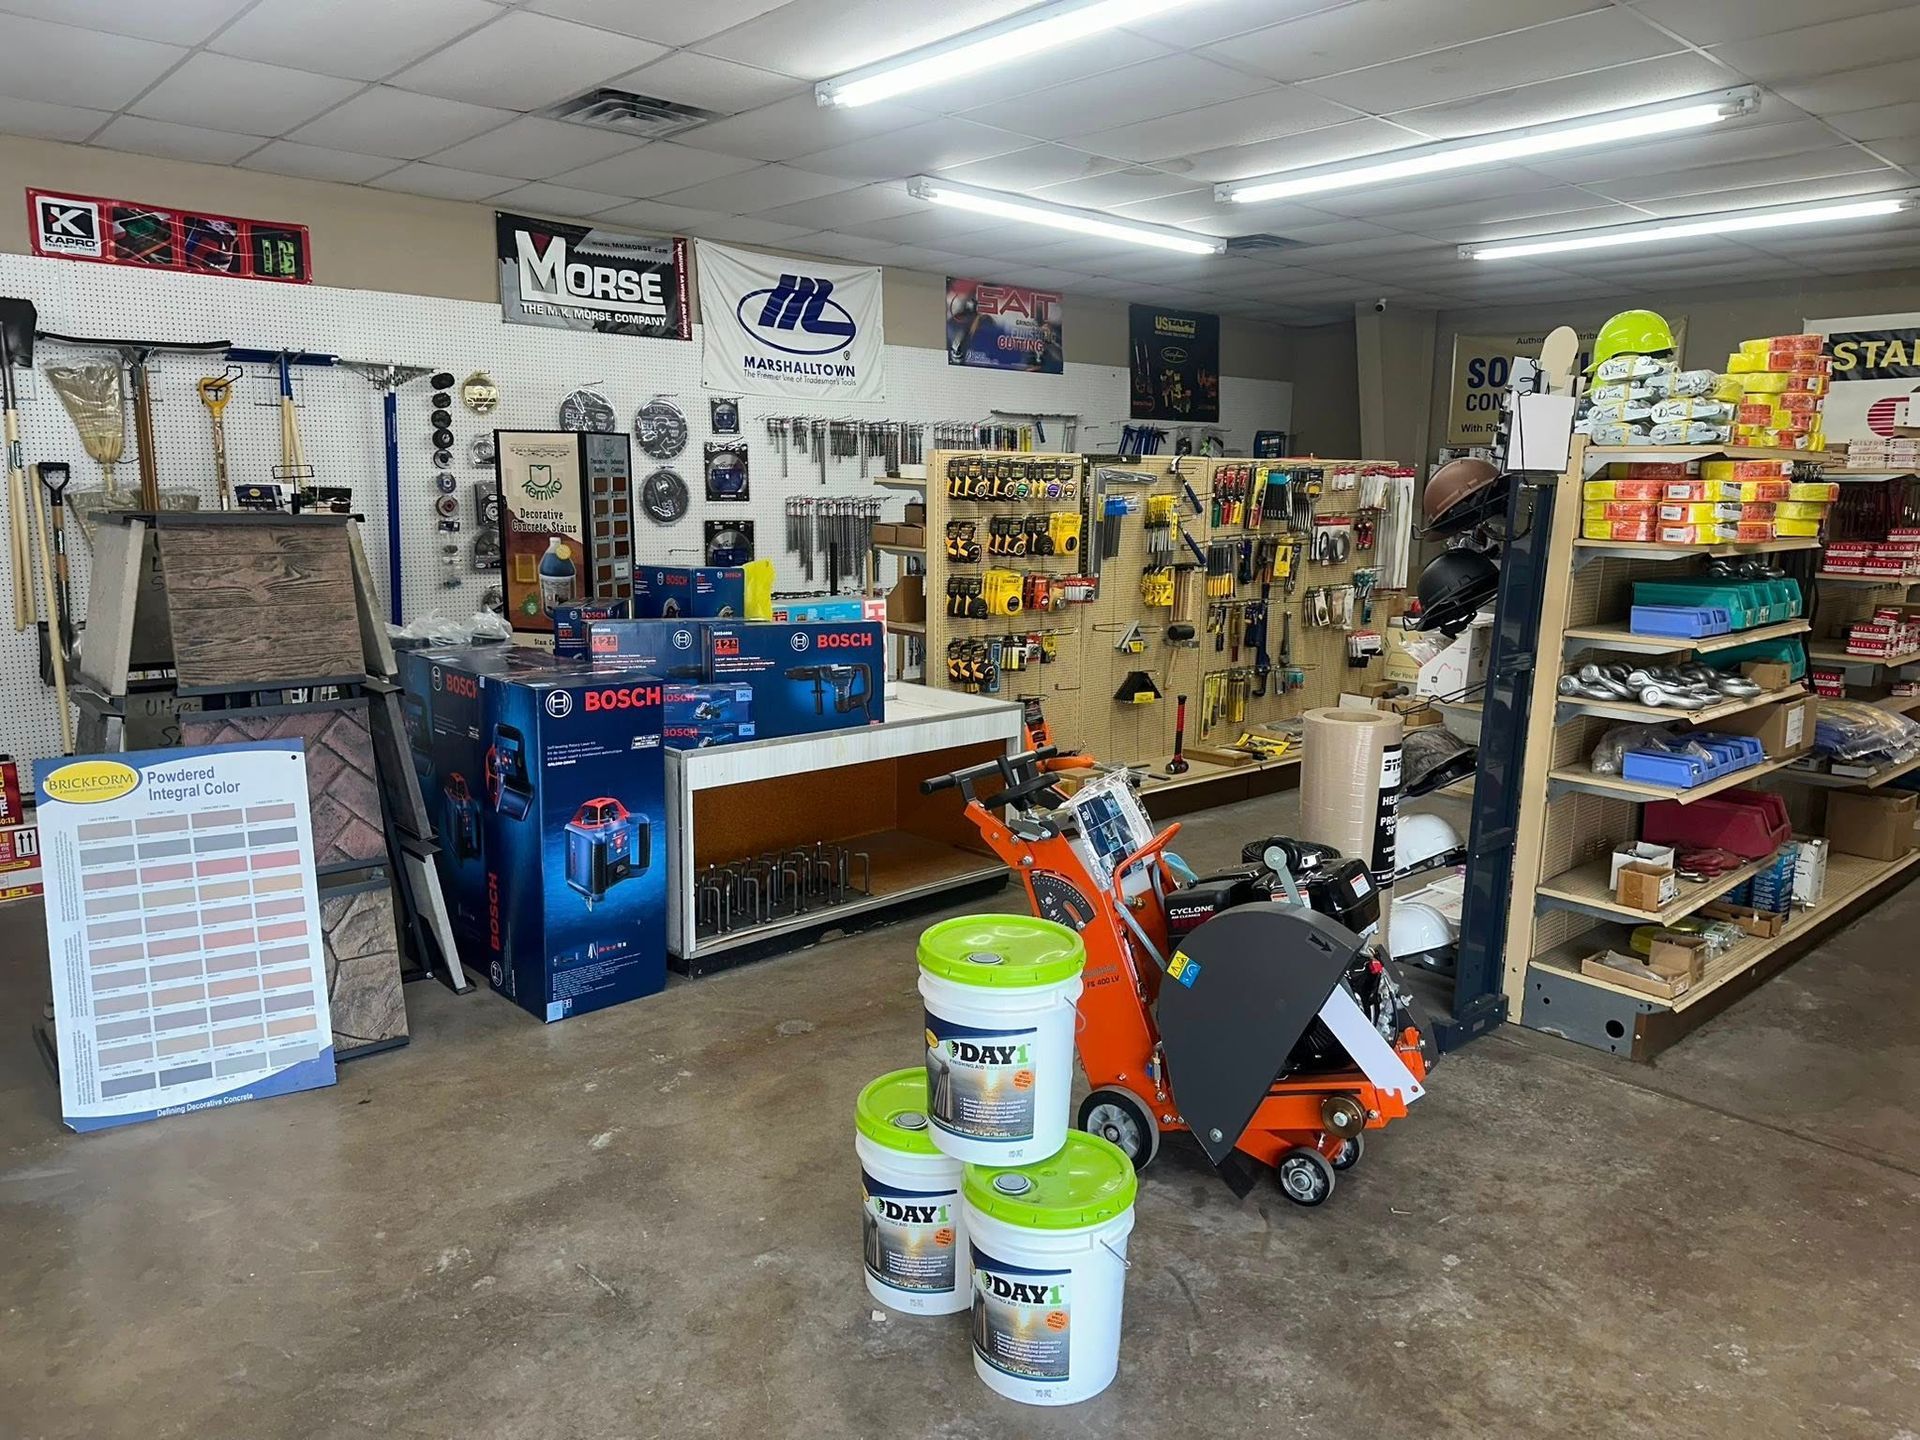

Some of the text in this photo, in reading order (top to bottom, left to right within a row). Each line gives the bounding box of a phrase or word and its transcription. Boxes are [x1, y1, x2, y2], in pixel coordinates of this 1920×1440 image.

[44, 235, 96, 248] KAPRO
[515, 230, 664, 305] MORSE
[976, 285, 1056, 321] SAIT
[520, 303, 667, 327] THE M.K. MORSE COMPANY
[1155, 315, 1169, 330] US
[997, 335, 1045, 352] CUTTING
[744, 356, 856, 377] MARSHALLTOWN
[743, 369, 756, 378] The
[756, 370, 782, 381] Premier
[841, 378, 857, 386] Tools
[1466, 392, 1505, 412] CON
[1461, 423, 1502, 433] With Ra
[520, 508, 564, 520] Decorative
[512, 520, 577, 534] Concrete Stains
[1891, 527, 1920, 535] MILTO
[1826, 559, 1860, 567] MILTON
[665, 574, 688, 586] BOSCH
[581, 611, 608, 619] BOSCH
[1853, 625, 1886, 633] MILTON
[817, 632, 872, 649] BOSCH
[1850, 641, 1884, 649] MILTON
[1389, 670, 1413, 679] For You
[584, 686, 661, 712] BOSCH
[49, 773, 134, 791] BRICKFORM
[147, 766, 215, 785] Powdered
[148, 780, 241, 801] Integral Color
[488, 871, 500, 950] BOSCH
[1169, 904, 1214, 916] CYCLONE
[1097, 978, 1111, 986] 400
[1112, 975, 1120, 983] LV
[959, 1042, 1029, 1065] DAY1
[157, 1092, 254, 1118] Defining Decorative Concrete
[885, 1200, 949, 1224] DAY1
[993, 1275, 1062, 1305] DAY1
